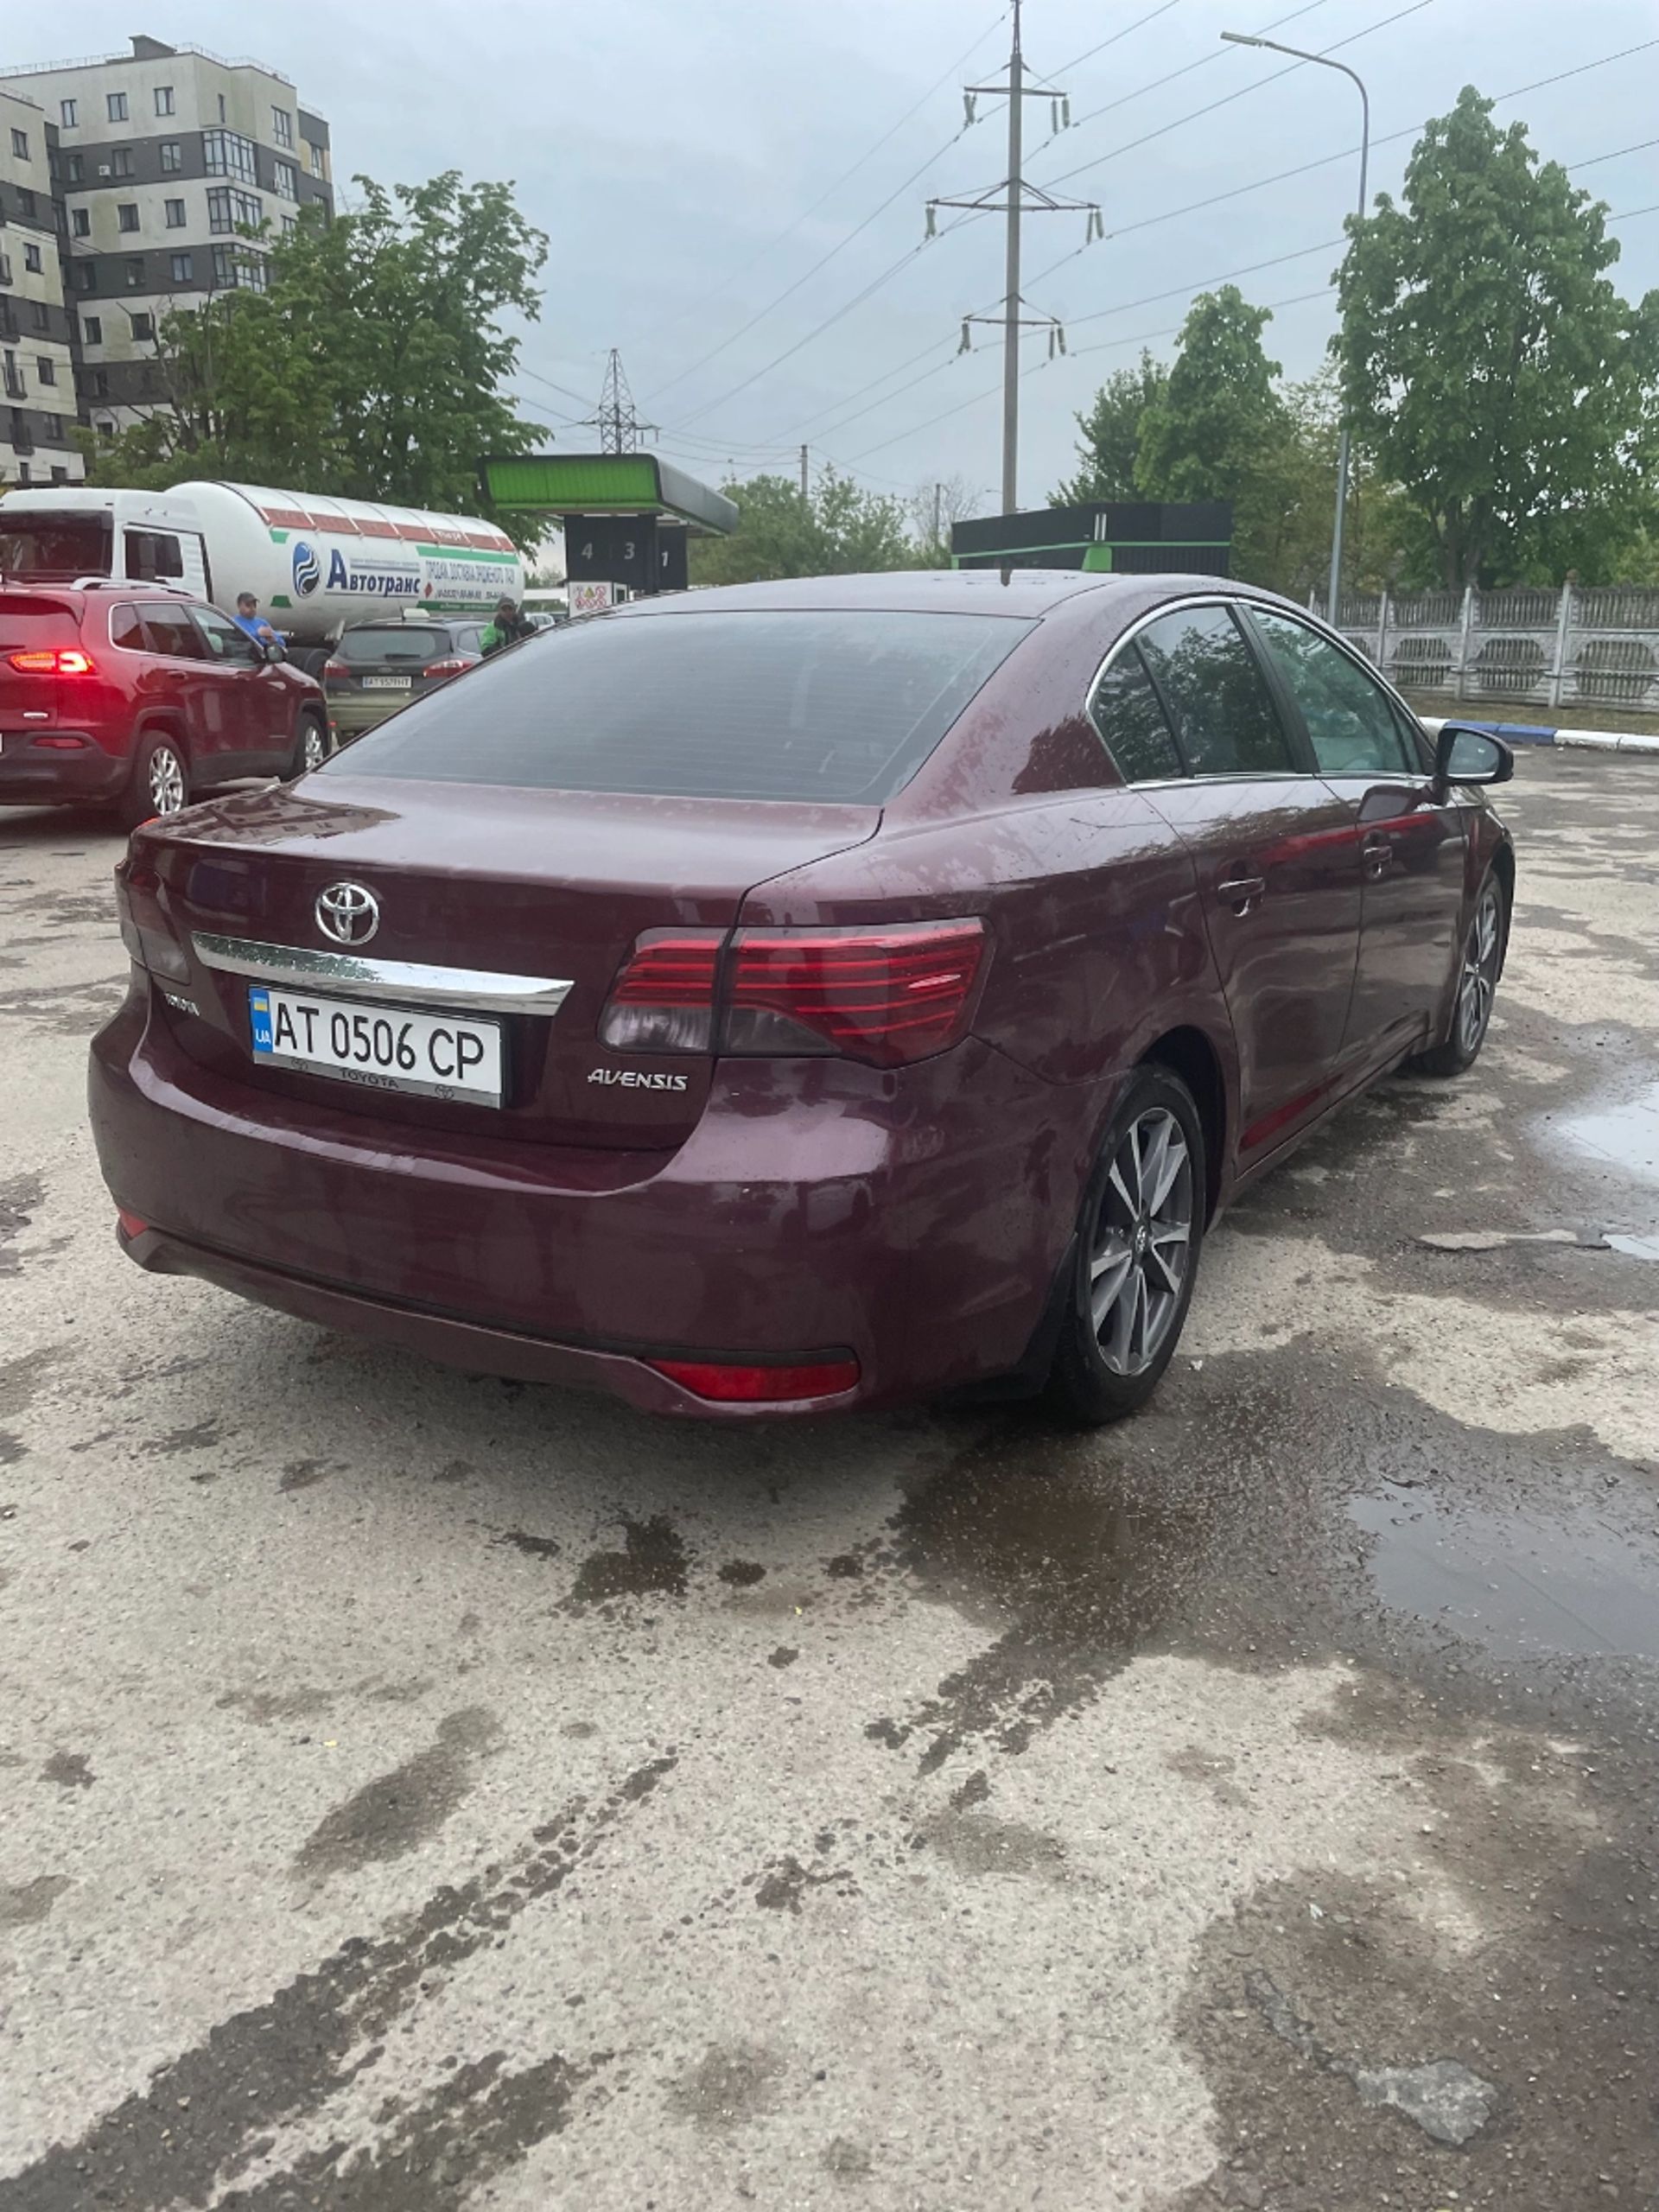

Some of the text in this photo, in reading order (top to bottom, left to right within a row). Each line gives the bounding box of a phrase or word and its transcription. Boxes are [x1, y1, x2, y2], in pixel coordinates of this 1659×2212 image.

[581, 542, 594, 560] 4
[624, 541, 636, 560] 3
[661, 550, 670, 567] 1
[326, 548, 421, 597] Автотранс
[255, 1028, 272, 1045] UA
[274, 1001, 485, 1080] AT 0506 CP
[340, 1067, 399, 1090] TOYOTA
[587, 1068, 689, 1090] AVENSIS
